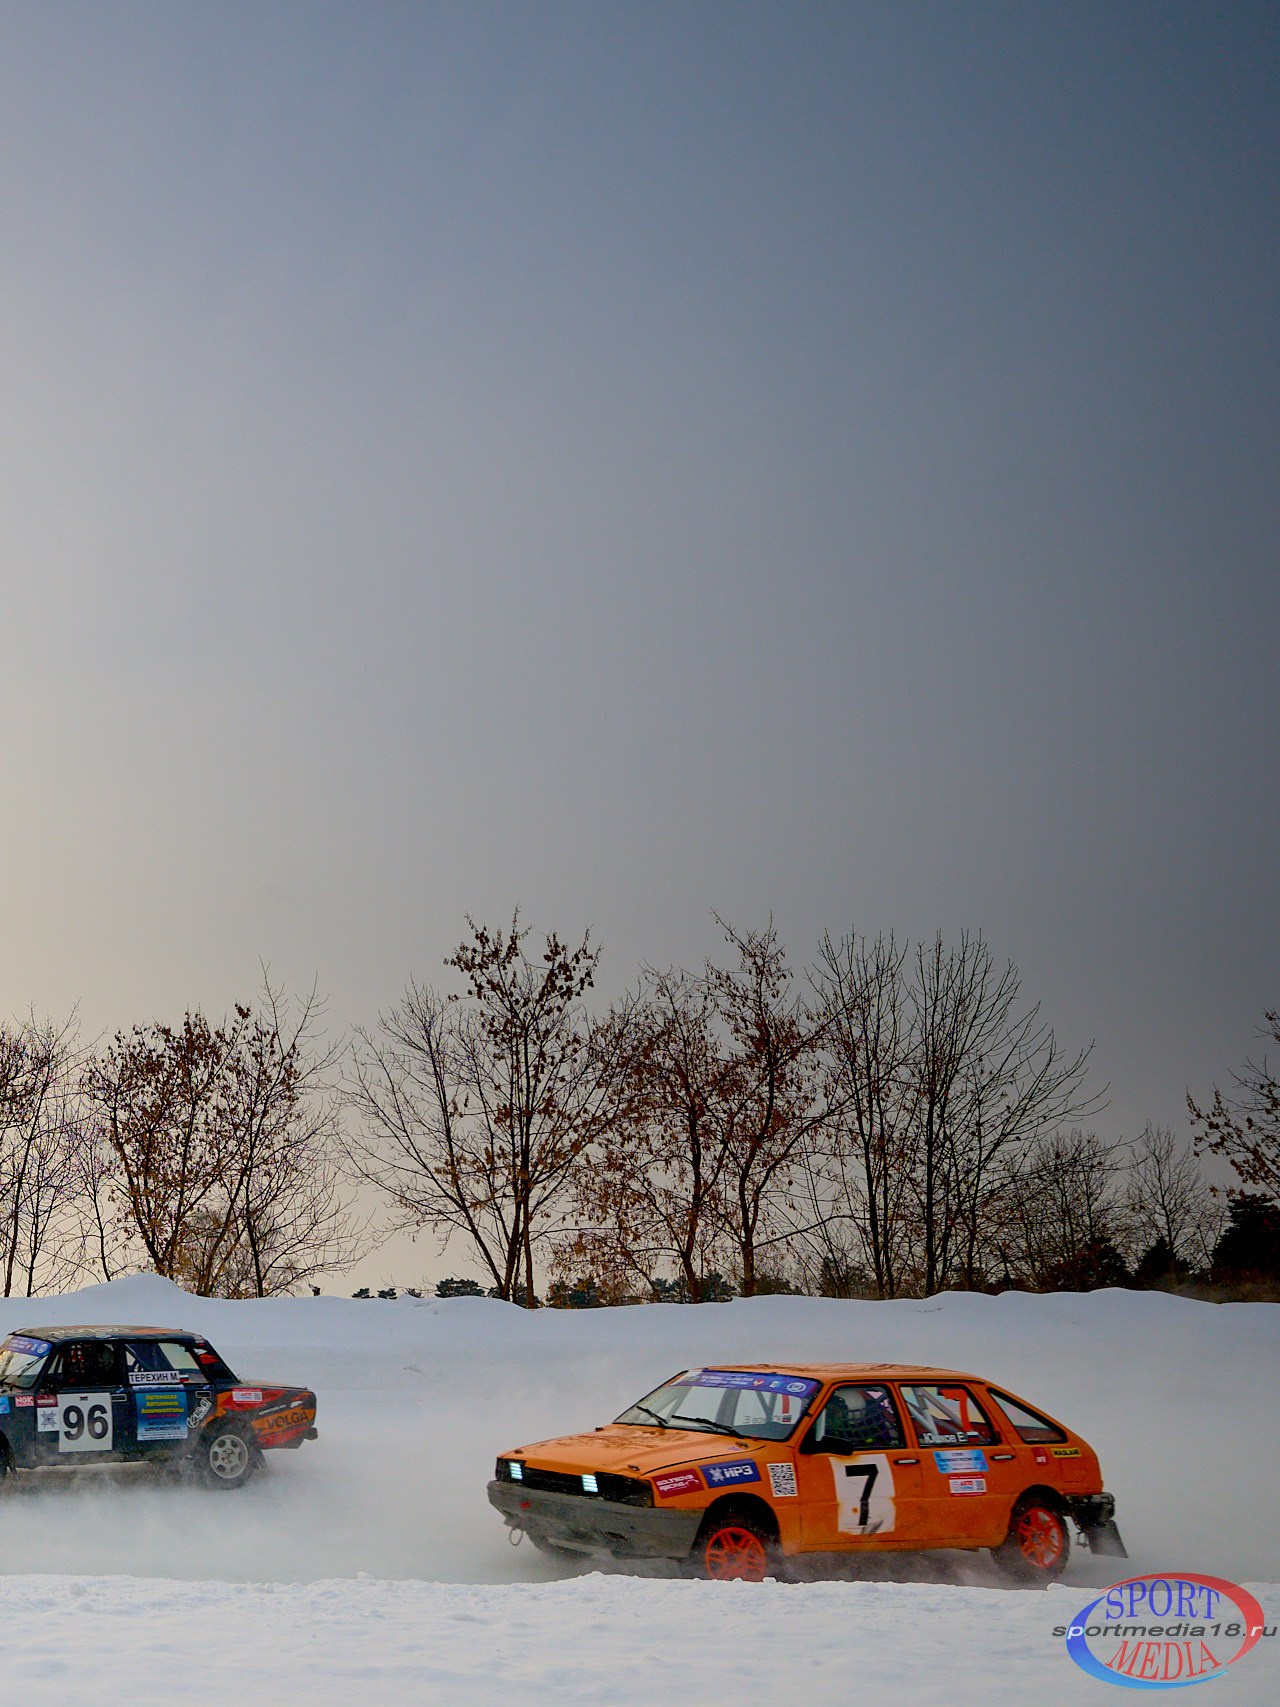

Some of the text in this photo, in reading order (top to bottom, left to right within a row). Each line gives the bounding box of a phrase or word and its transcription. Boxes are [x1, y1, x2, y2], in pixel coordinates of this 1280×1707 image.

[129, 1373, 168, 1382] ТЕРЕХИН
[63, 1404, 109, 1441] 96
[267, 1412, 309, 1429] VOLGA
[723, 1465, 754, 1478] ИРЗ
[844, 1463, 879, 1526] 7
